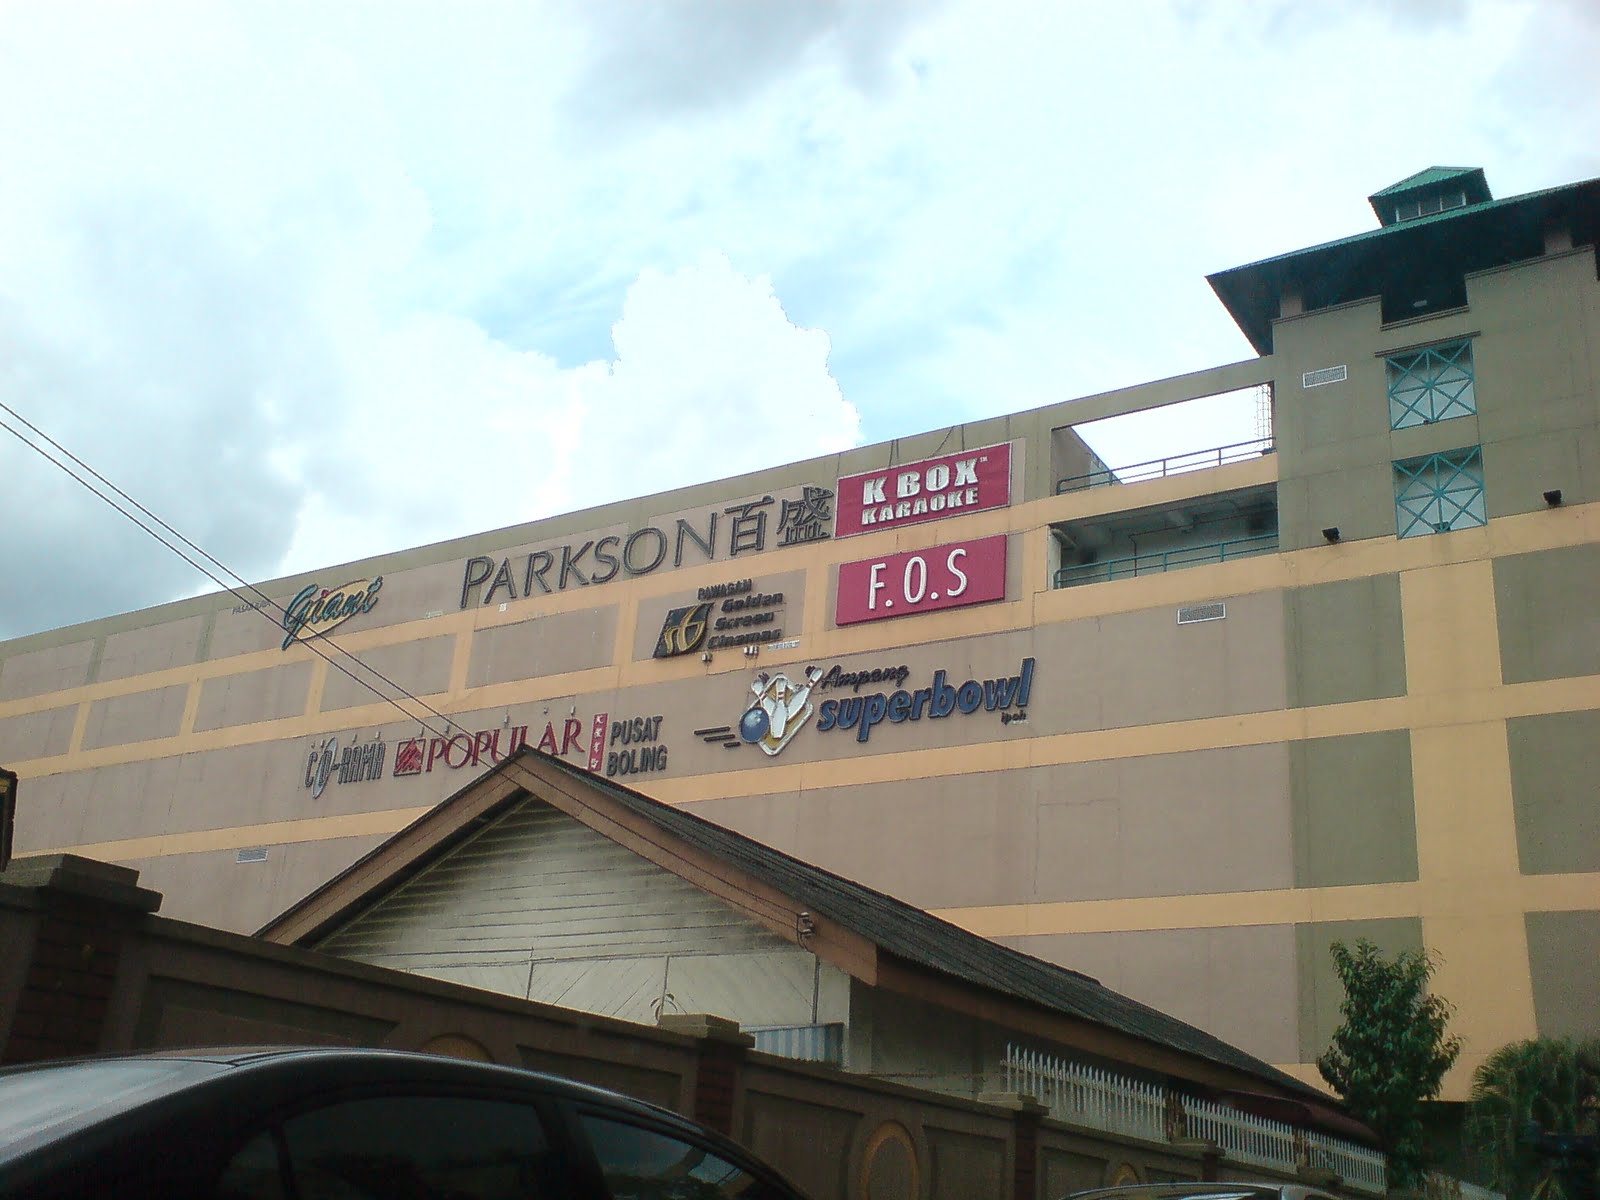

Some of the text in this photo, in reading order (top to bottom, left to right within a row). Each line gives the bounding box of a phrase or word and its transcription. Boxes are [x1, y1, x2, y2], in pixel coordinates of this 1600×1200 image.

[863, 476, 888, 505] K
[897, 458, 979, 498] BOX
[861, 487, 979, 526] KARAOKE
[459, 485, 836, 609] PARKSON 百盛
[868, 548, 968, 610] F.O.S
[281, 576, 383, 651] Giant
[714, 611, 774, 630] Screen
[721, 592, 783, 612] Golden
[820, 664, 910, 693] Ampang
[817, 656, 1036, 743] superbowl
[609, 715, 664, 746] PUSAT
[606, 744, 668, 777] BOLING
